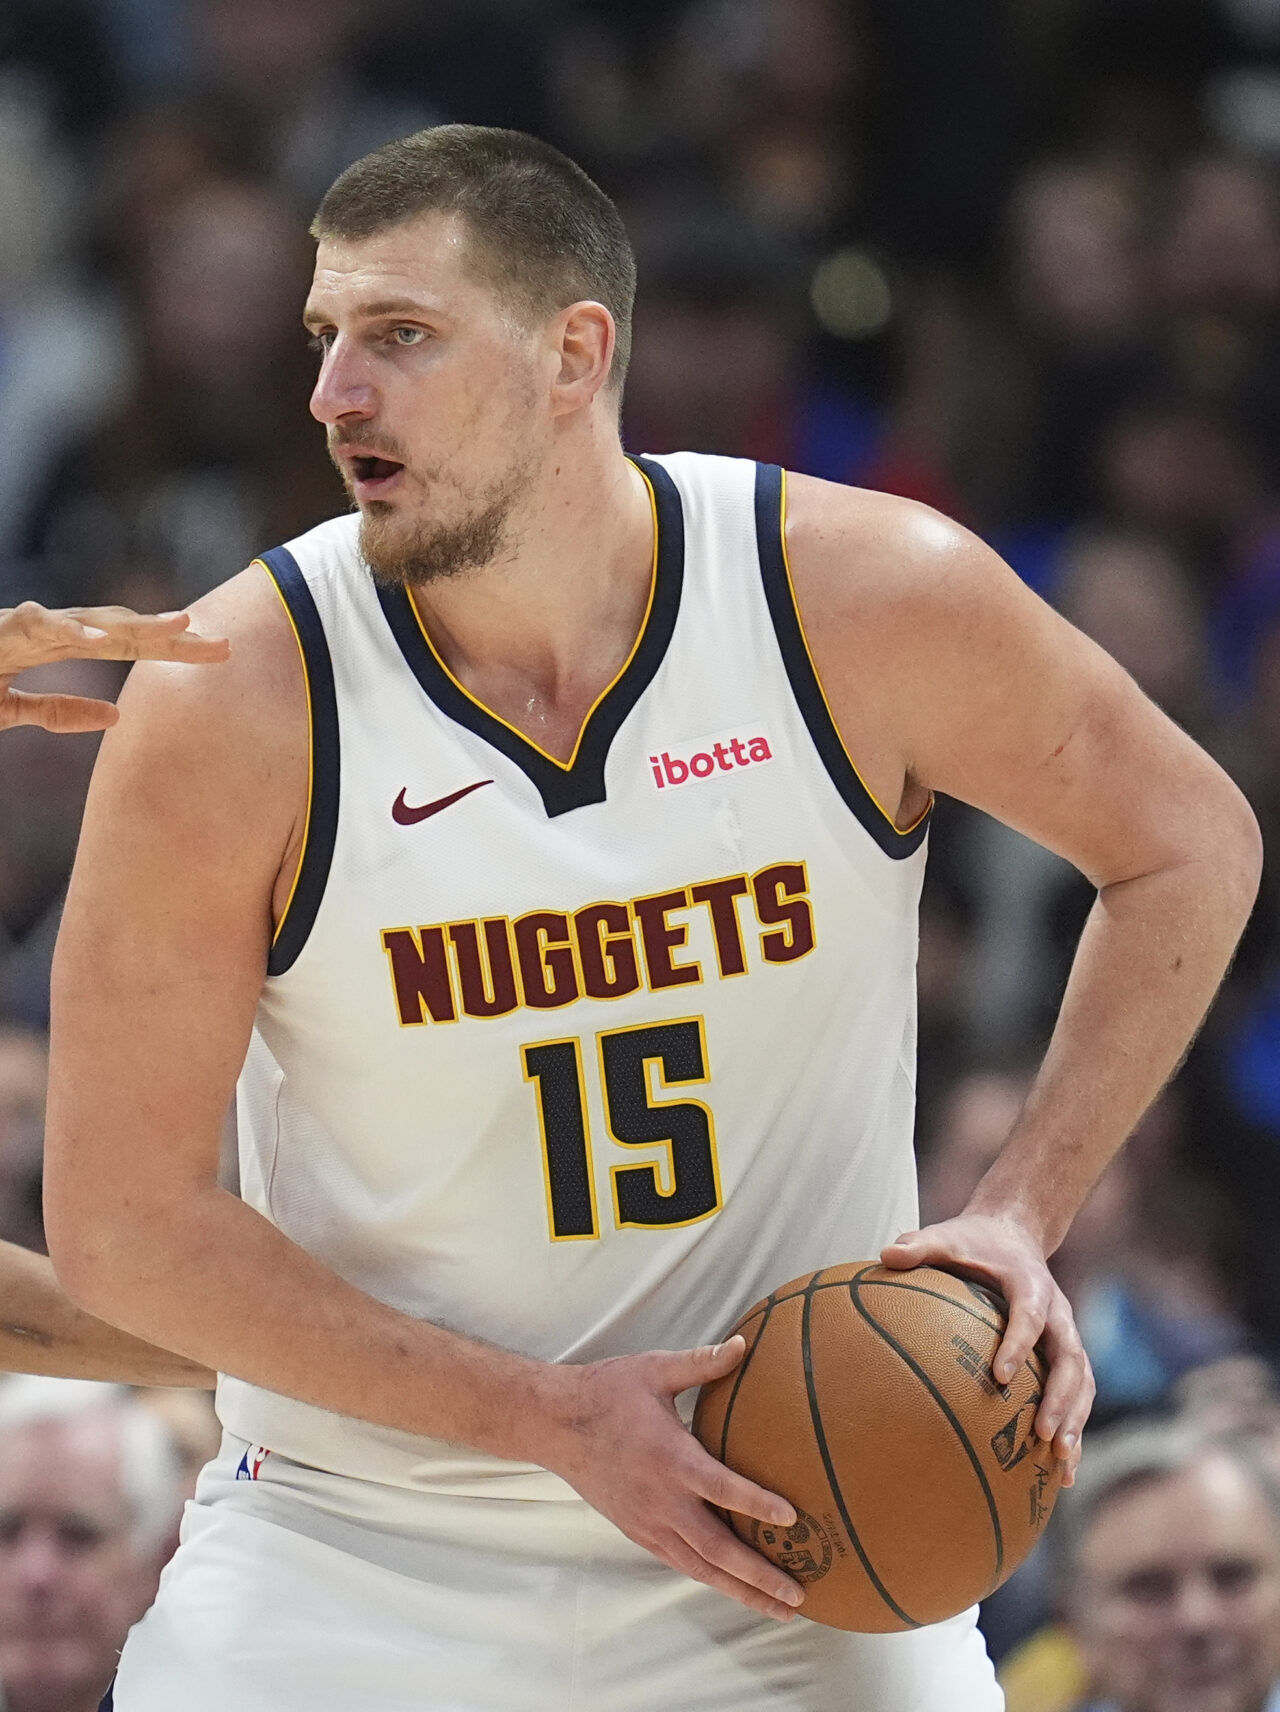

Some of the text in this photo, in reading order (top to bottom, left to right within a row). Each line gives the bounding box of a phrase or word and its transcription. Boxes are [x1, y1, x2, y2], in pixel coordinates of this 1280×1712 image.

[650, 735, 773, 789] ibotta
[380, 860, 816, 1028] NUGGETS
[519, 1014, 724, 1243] 15
